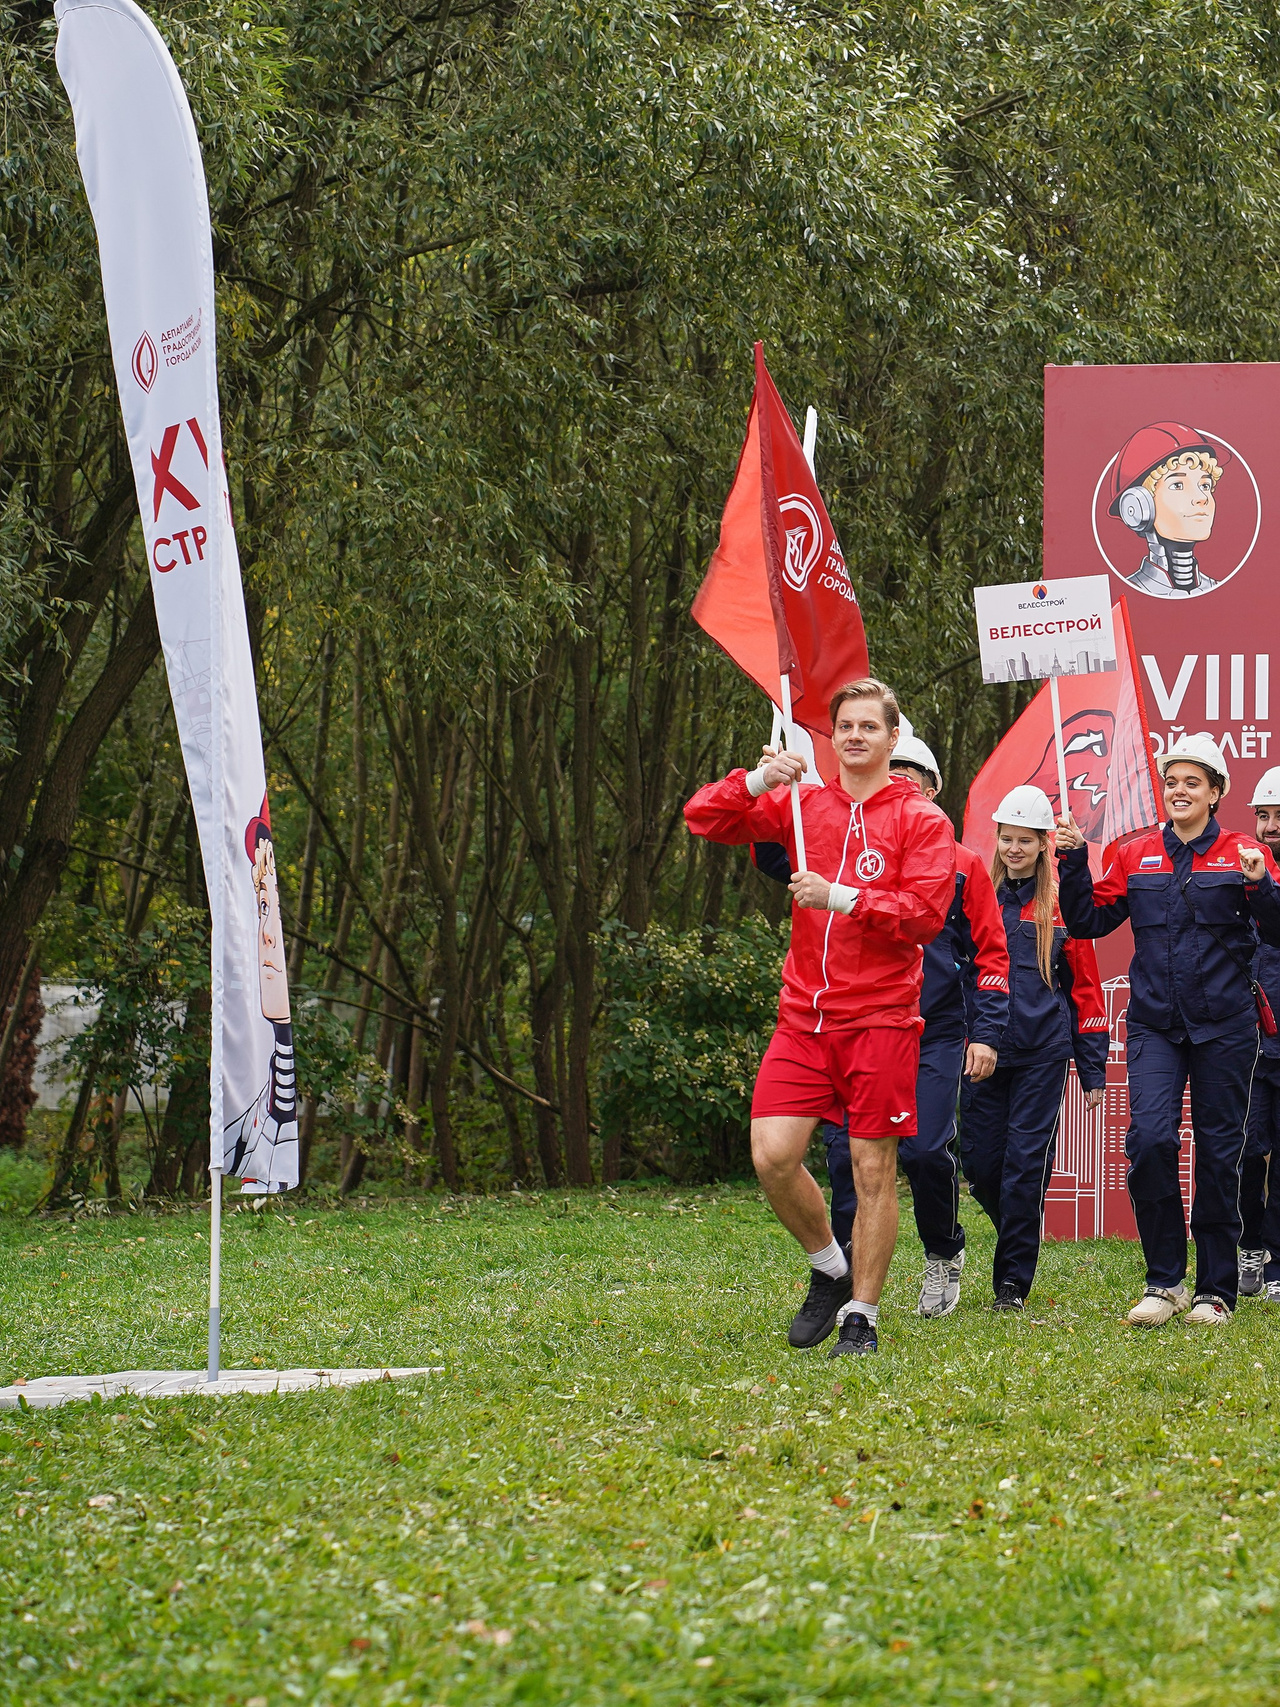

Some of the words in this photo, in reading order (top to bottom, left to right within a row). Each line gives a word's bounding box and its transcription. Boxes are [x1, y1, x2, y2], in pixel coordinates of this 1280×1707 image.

[817, 572, 857, 604] ГОРОДА
[1018, 598, 1065, 610] ВЕЛЕССТРОЙ
[989, 614, 1102, 640] ВЕЛЕССТРОЙ
[1141, 654, 1269, 720] VIII
